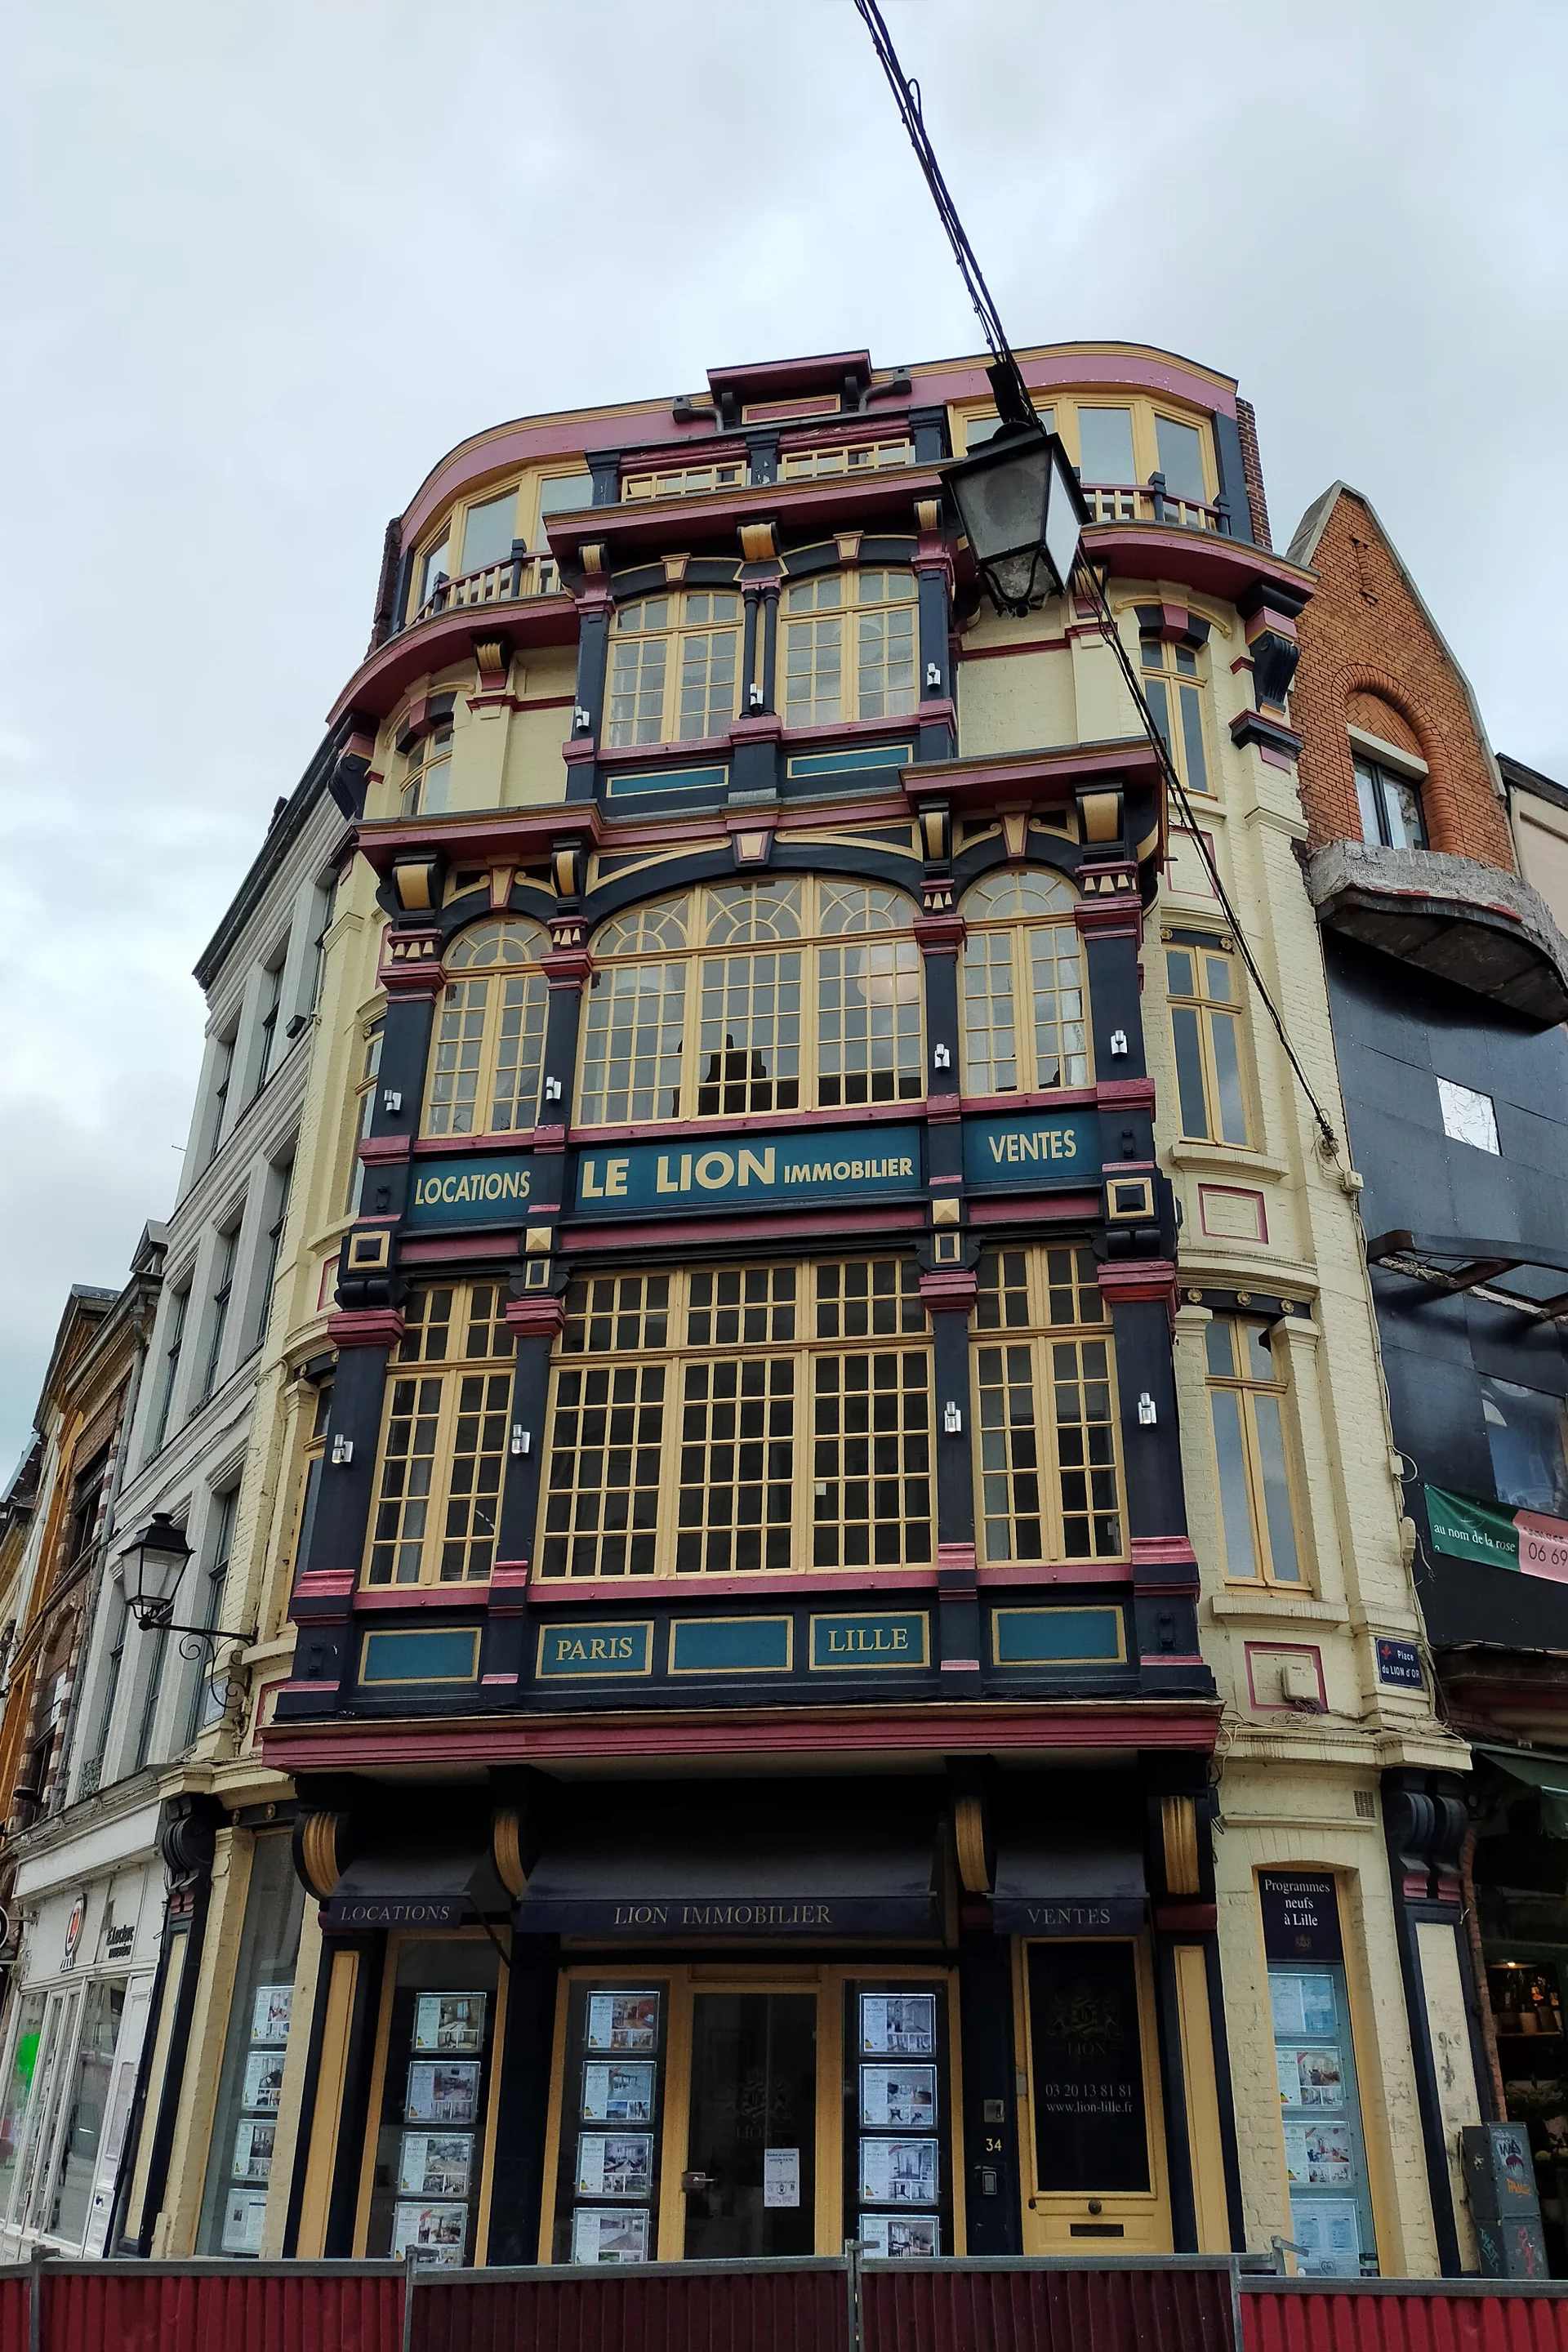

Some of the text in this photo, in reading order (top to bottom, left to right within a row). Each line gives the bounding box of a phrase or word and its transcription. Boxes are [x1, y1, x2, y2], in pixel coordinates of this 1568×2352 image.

[989, 1129, 1076, 1163] VENTES
[582, 1147, 913, 1198] LE LION IMMOBILIER
[415, 1170, 530, 1205] LOCATIONS
[1434, 1524, 1516, 1552] au nom de la rose
[1529, 1542, 1568, 1566] 06 69
[828, 1628, 909, 1652] LILLE
[556, 1637, 633, 1661] PARIS
[1396, 1650, 1414, 1662] Place
[1382, 1664, 1390, 1674] du
[1390, 1666, 1405, 1677] LION
[1264, 1878, 1330, 1895] Programmes
[1285, 1896, 1314, 1909] neufs
[341, 1905, 450, 1921] LOCATIONS
[614, 1904, 832, 1925] LION IMMOBILIER
[1027, 1908, 1111, 1924] VENTES
[1284, 1913, 1318, 1927] à Lille
[1045, 2083, 1132, 2098] 03 20 13 81 81
[1046, 2100, 1134, 2114] www.lion-lille.fr
[986, 2138, 1003, 2153] 34
